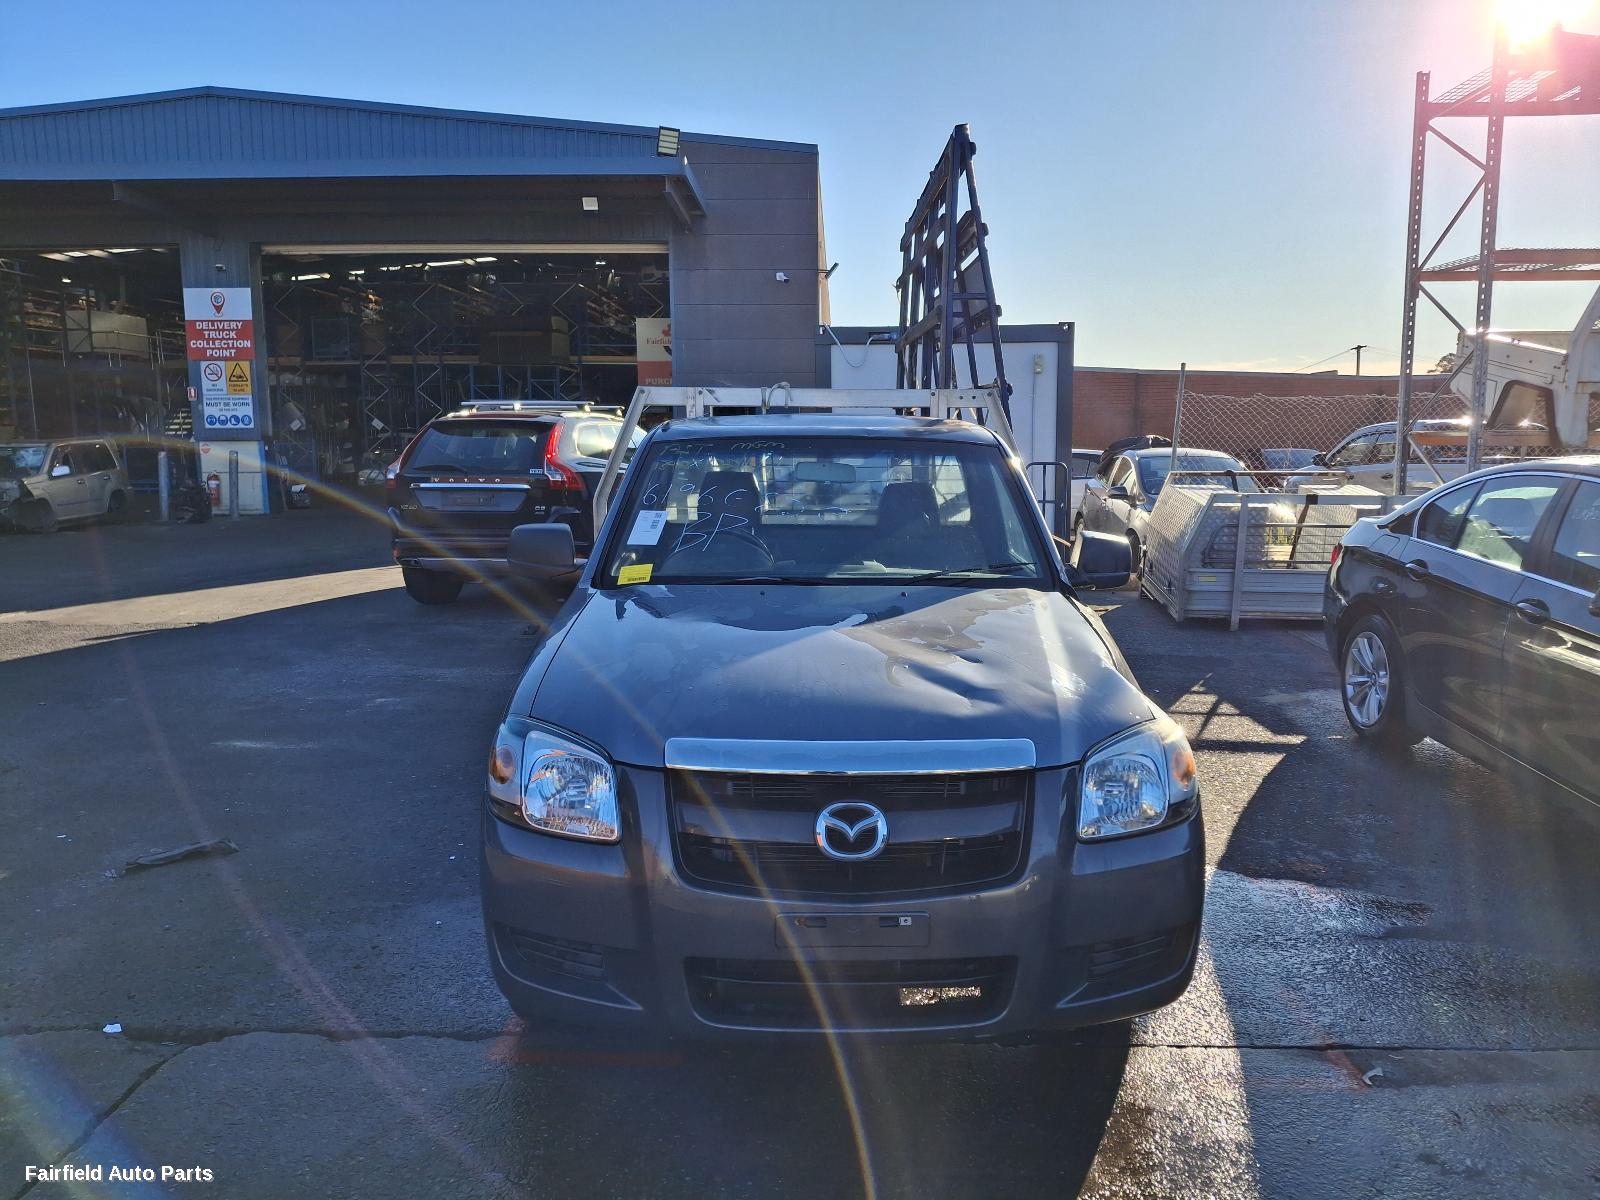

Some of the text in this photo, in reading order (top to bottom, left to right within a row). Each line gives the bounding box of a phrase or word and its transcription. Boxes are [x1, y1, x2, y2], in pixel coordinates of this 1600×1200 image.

[196, 321, 242, 329] DELIVERY
[203, 331, 237, 339] TRUCK
[190, 340, 251, 348] COLLECTION
[646, 337, 672, 345] Fairfiel
[206, 349, 236, 358] POINT
